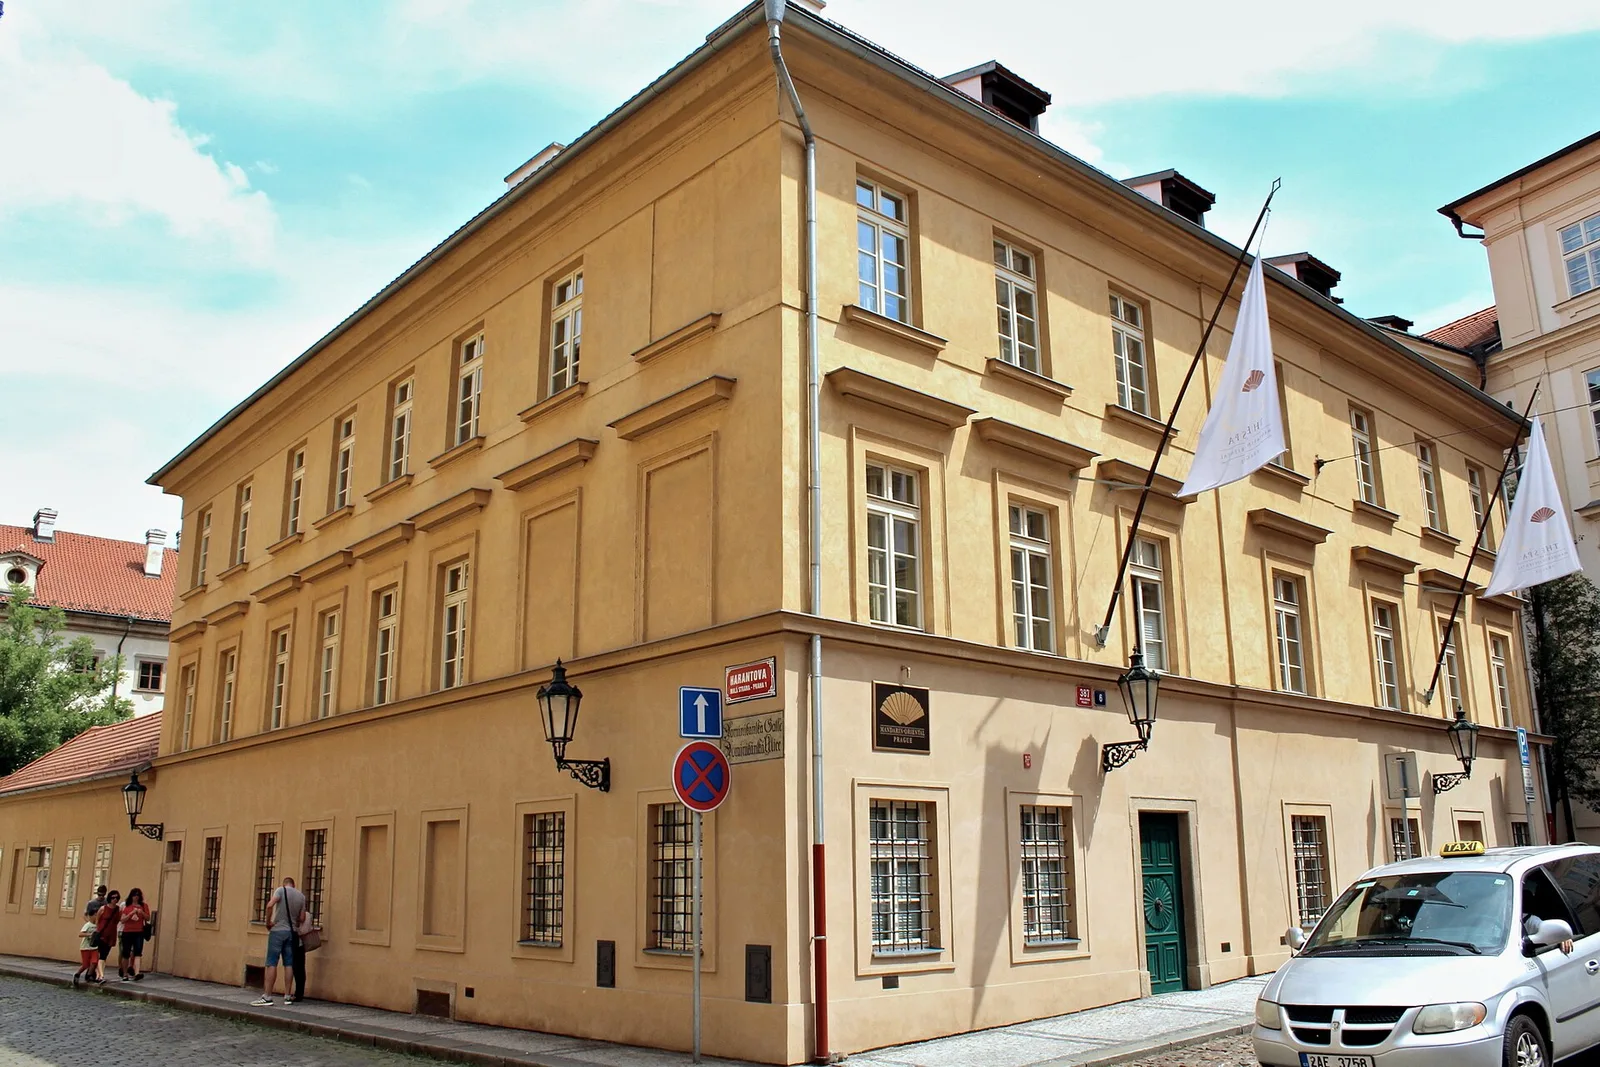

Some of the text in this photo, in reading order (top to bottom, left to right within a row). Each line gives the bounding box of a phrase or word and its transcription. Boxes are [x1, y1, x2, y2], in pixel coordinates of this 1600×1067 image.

[730, 668, 767, 686] HARANTOVA
[1447, 842, 1477, 852] TAXI
[1310, 1056, 1330, 1067] 2AE
[1338, 1057, 1367, 1067] 3758
